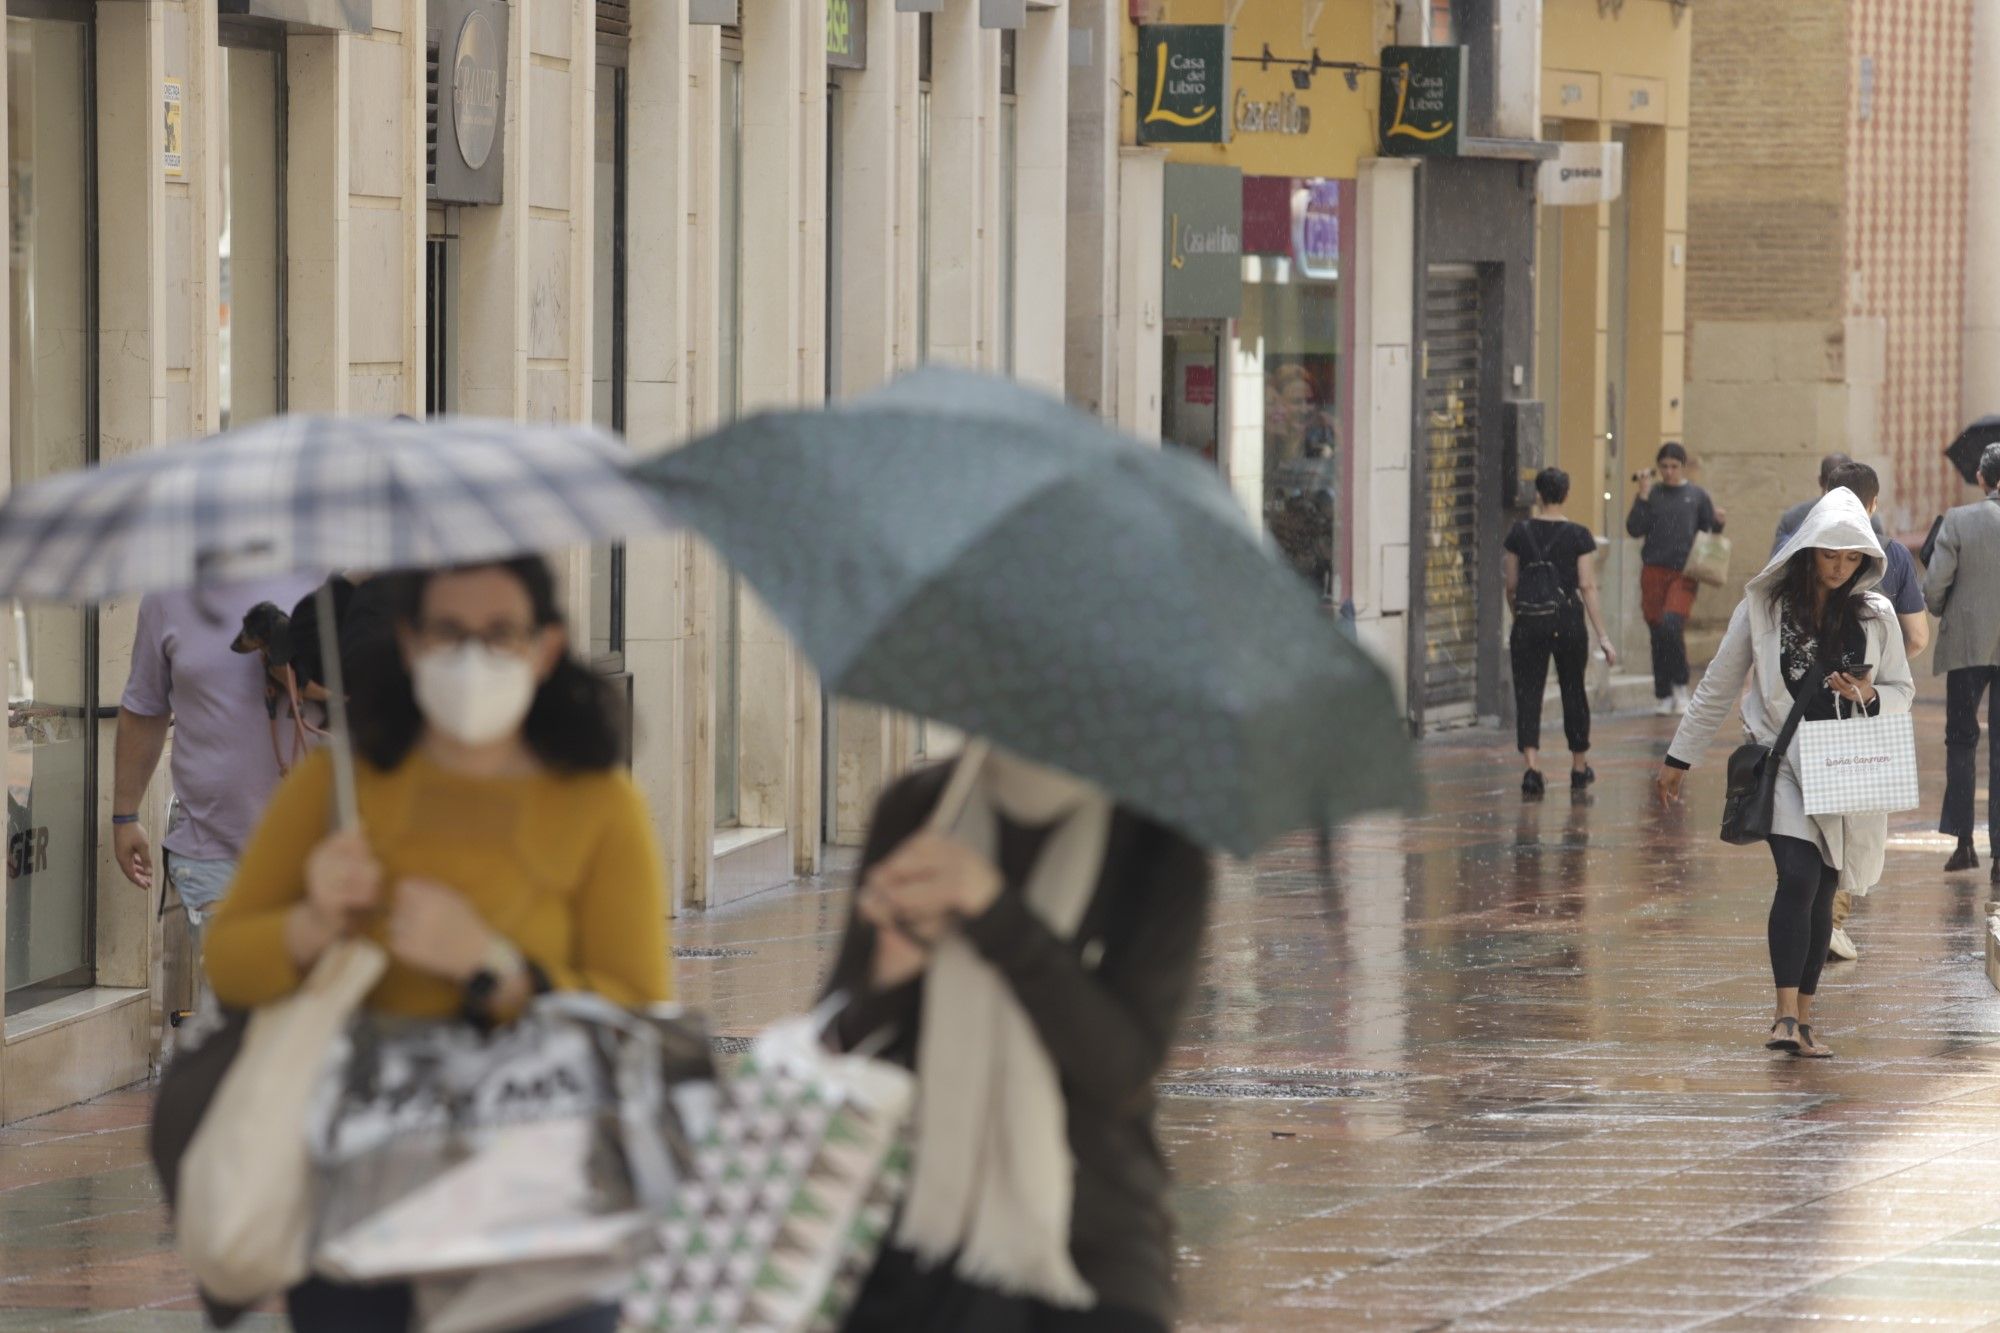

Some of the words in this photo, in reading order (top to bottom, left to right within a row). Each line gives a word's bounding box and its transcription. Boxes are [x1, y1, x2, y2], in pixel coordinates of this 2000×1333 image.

[826, 0, 849, 54] ase
[1170, 54, 1205, 69] Casa
[1187, 70, 1206, 81] del
[1411, 74, 1443, 88] Casa
[1169, 80, 1206, 94] Libro
[1426, 88, 1443, 99] del
[1233, 87, 1264, 132] Casa
[1409, 97, 1443, 111] Libro
[1825, 757, 1851, 767] Doña
[1853, 755, 1891, 765] Carmen
